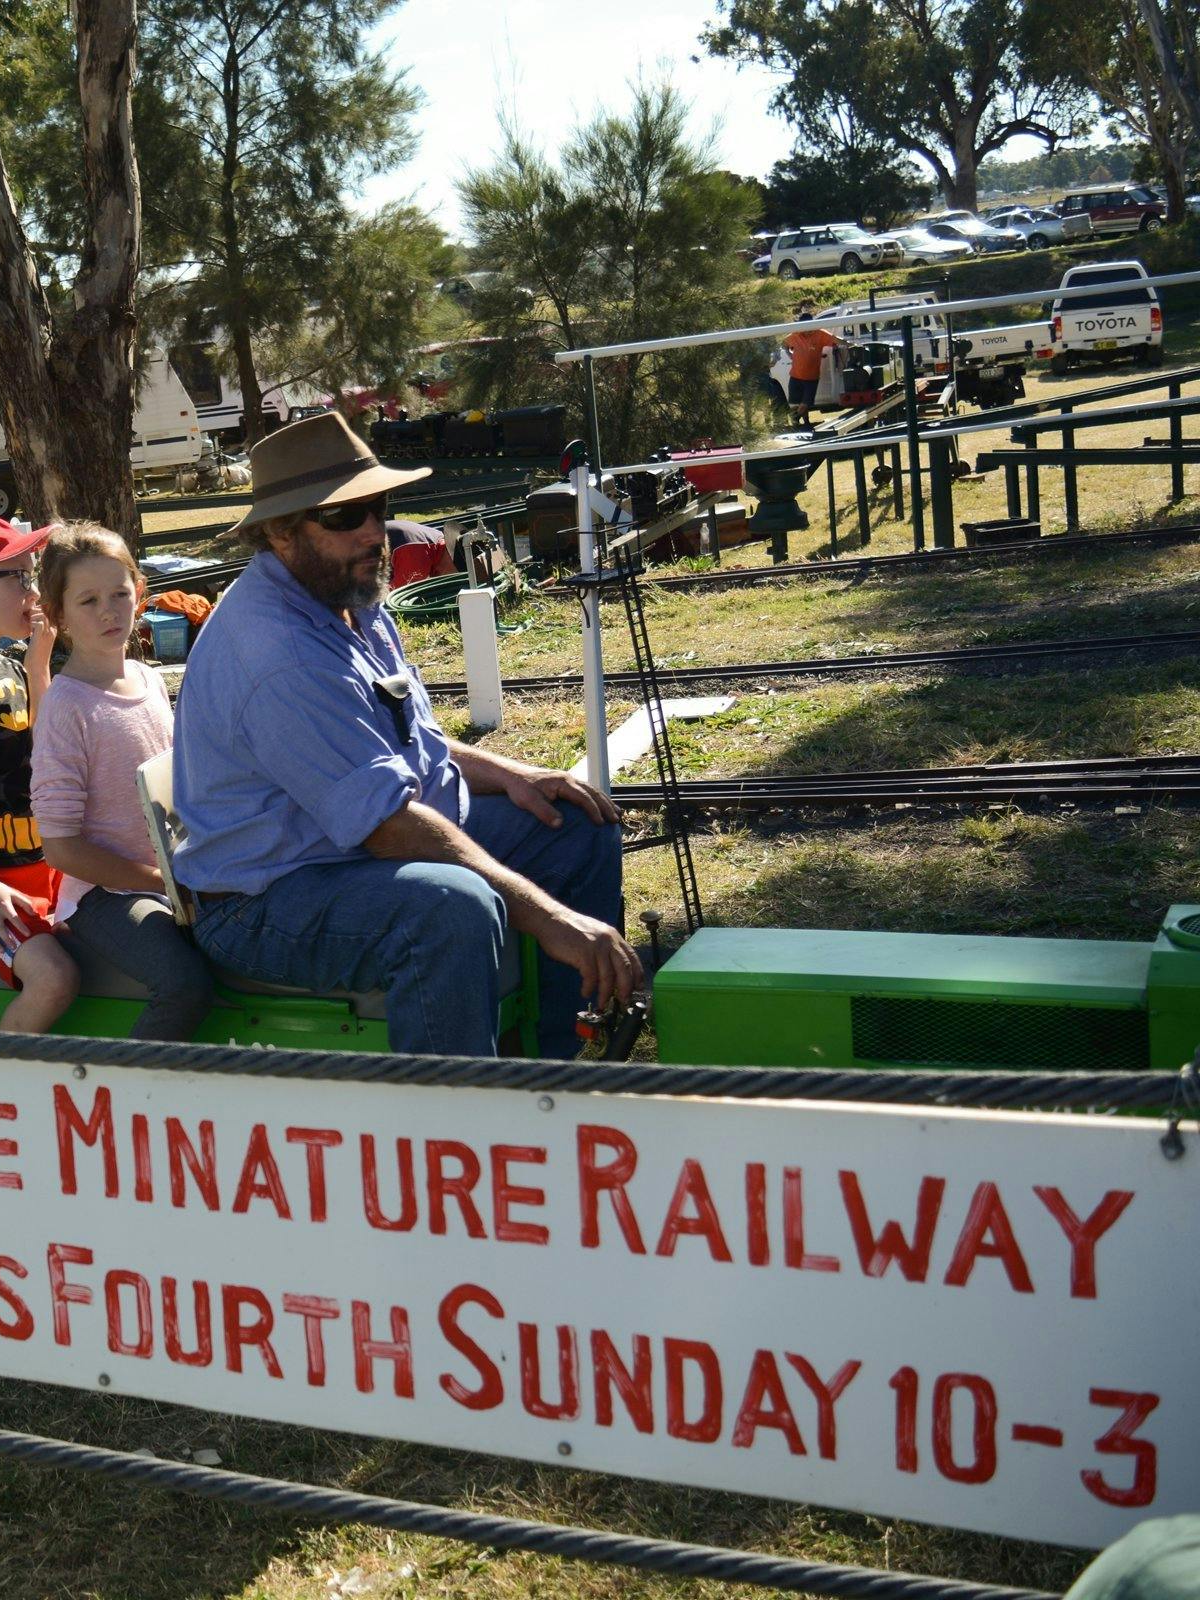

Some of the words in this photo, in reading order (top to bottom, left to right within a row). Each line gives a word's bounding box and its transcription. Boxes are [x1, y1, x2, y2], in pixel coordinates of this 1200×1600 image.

[981, 337, 1007, 345] TOYOTA
[1075, 317, 1137, 332] TOYOTA
[53, 1084, 550, 1246] MINATURE
[576, 1124, 1134, 1300] RAILWAY
[47, 1243, 415, 1400] FOURTH
[437, 1284, 862, 1461] SUNDAY
[889, 1365, 1160, 1508] 10-3
